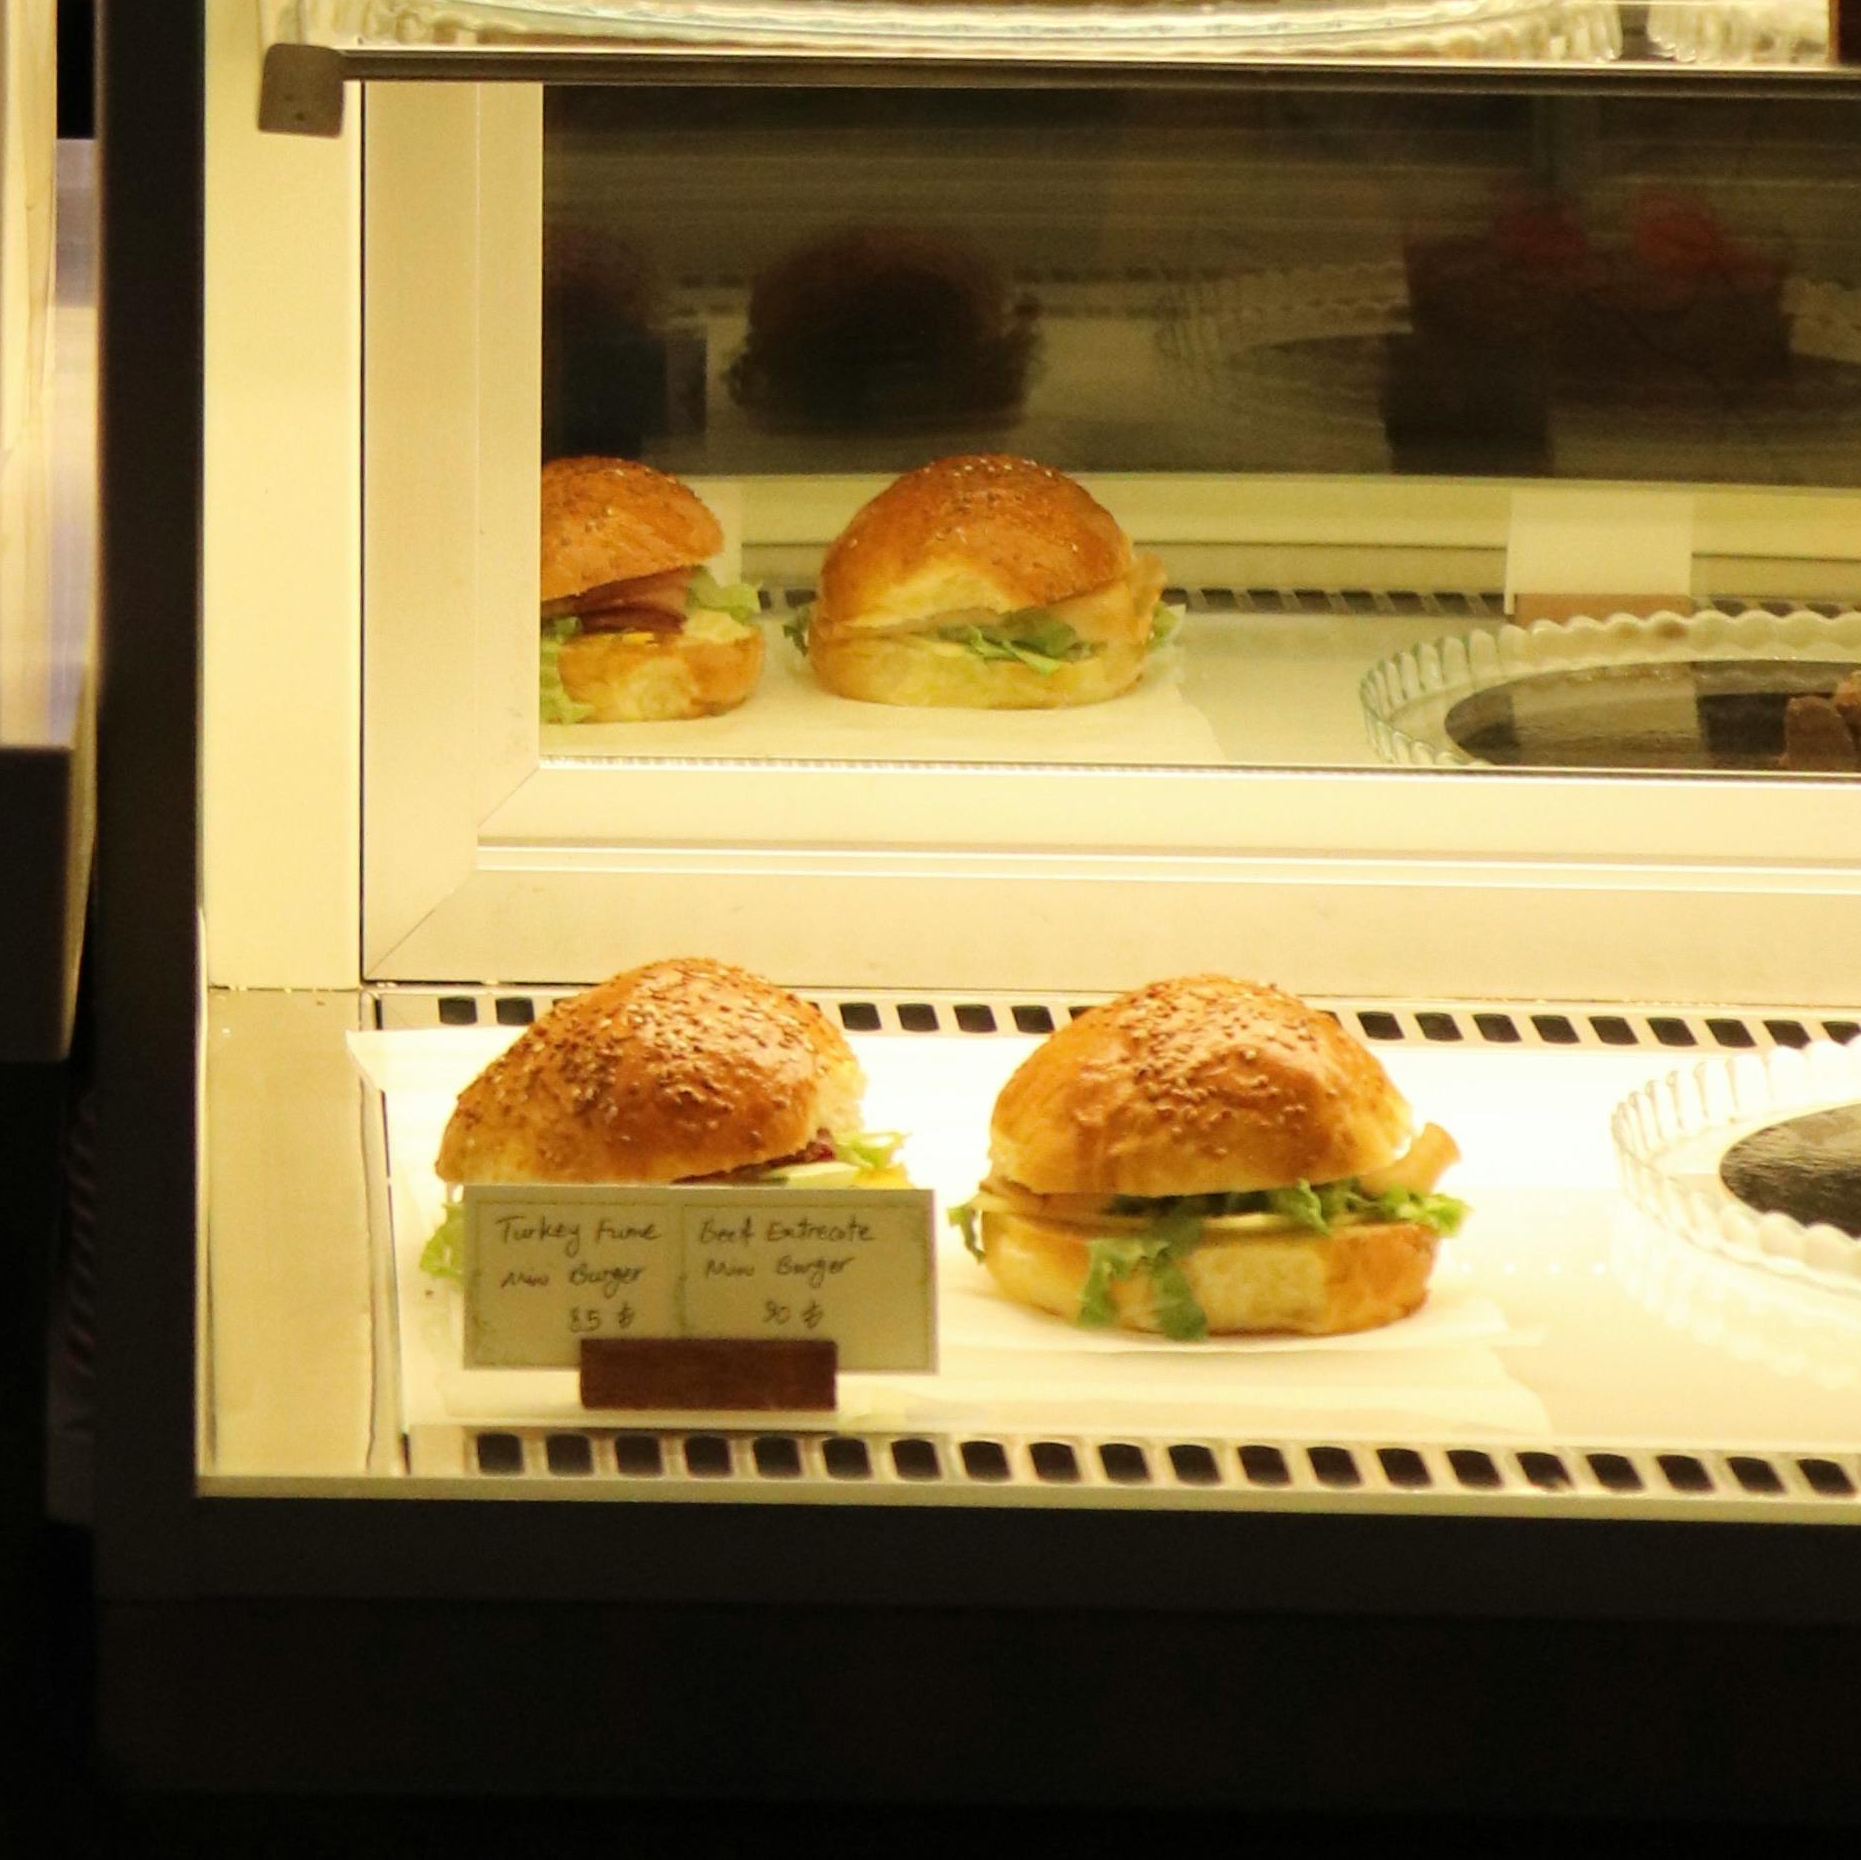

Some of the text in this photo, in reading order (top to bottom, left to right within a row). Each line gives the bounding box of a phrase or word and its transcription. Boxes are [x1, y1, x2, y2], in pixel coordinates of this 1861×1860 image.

[495, 1215, 581, 1259] Turkey
[699, 1214, 756, 1248] Beef
[569, 1262, 646, 1300] Burger
[775, 1254, 858, 1290] Burger
